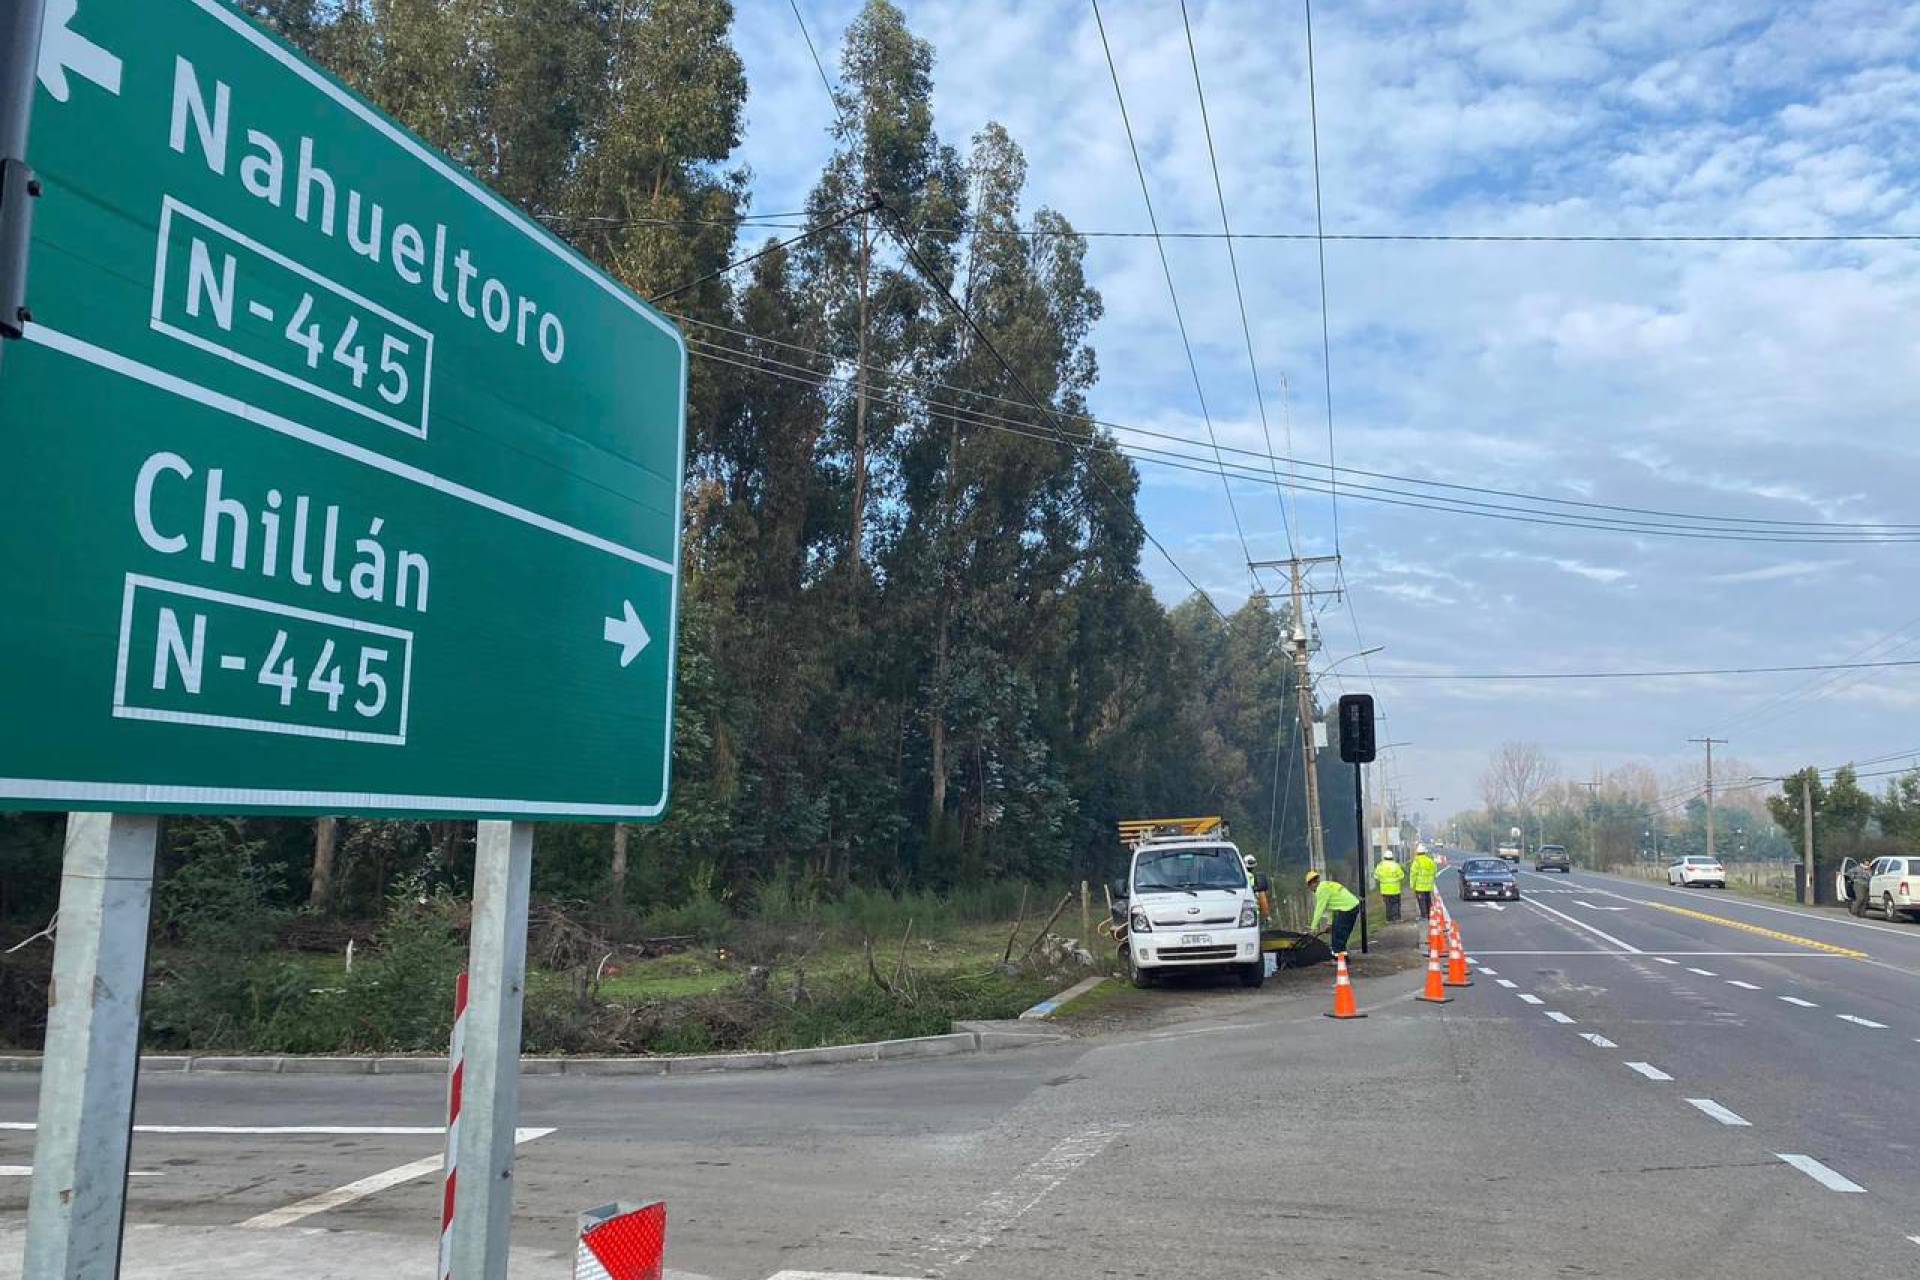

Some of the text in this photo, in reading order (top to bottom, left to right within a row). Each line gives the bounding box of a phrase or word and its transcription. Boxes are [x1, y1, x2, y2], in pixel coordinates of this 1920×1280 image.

[169, 55, 565, 365] Nahueltoro
[185, 238, 410, 405] N-445
[133, 451, 430, 613] Chillán
[151, 607, 389, 718] N-445
